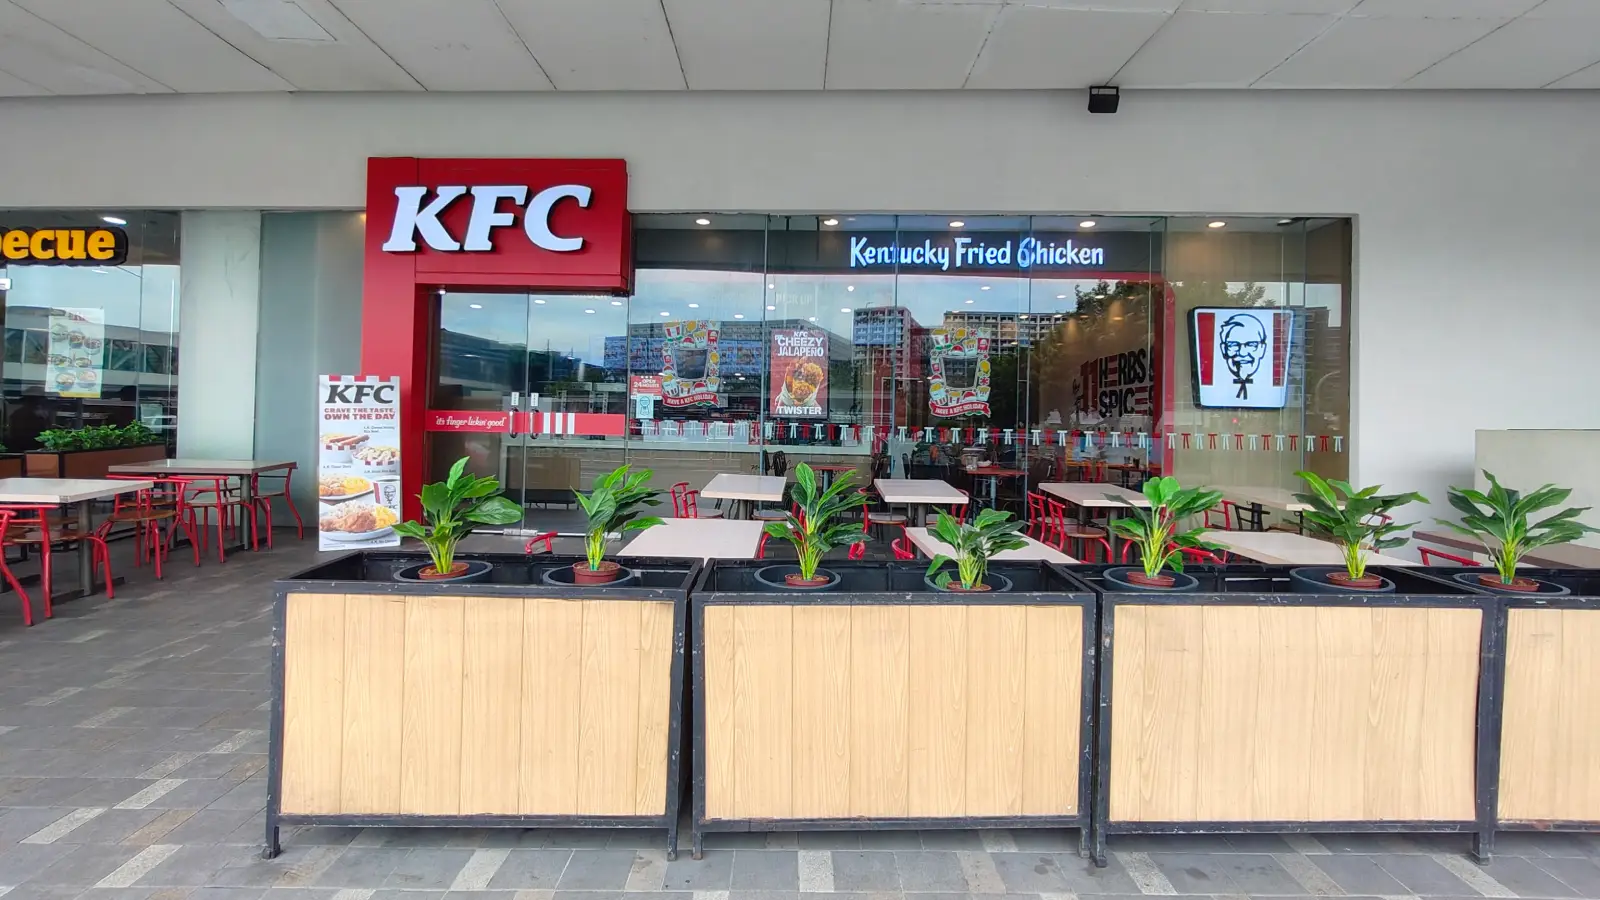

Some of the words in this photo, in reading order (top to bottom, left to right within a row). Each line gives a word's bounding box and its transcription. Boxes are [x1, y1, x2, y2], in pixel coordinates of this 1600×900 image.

[382, 184, 592, 252] KFC
[0, 228, 115, 261] ecue
[850, 236, 950, 271] Kentucky
[954, 236, 1011, 268] Fried
[1016, 236, 1104, 268] Chicken
[777, 337, 824, 347] CHEEZY
[777, 346, 824, 357] JALAPEÑO
[1099, 348, 1146, 388] HERBS
[325, 384, 395, 404] KFC
[666, 397, 680, 405] HAVE
[694, 393, 714, 402] HOLIDAY
[324, 413, 350, 421] OWN
[352, 413, 374, 421] THE
[375, 413, 396, 421] DAY
[777, 405, 822, 415] TWISTER
[446, 415, 468, 429] finger
